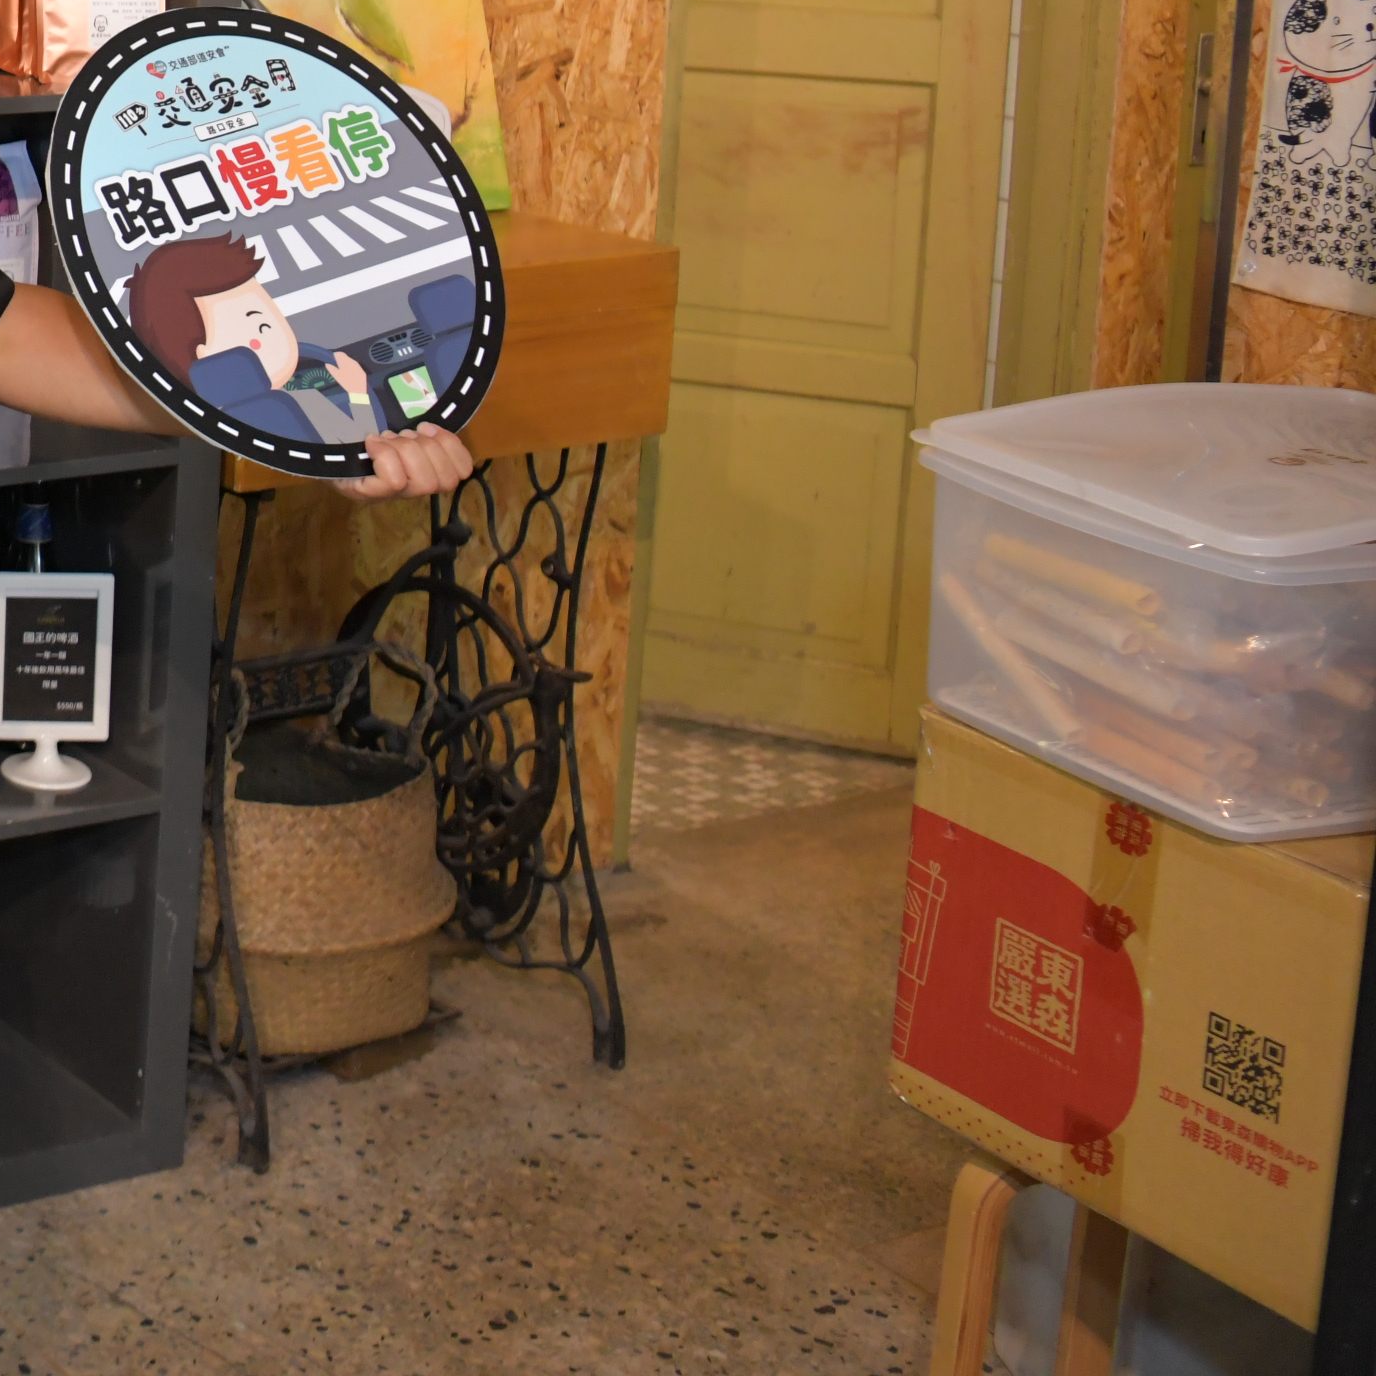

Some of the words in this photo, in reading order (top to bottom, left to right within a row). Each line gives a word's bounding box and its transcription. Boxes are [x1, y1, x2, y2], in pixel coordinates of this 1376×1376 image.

[167, 47, 226, 71] 交通部道安會
[206, 116, 246, 135] 路口安全
[100, 106, 392, 246] 路口慢看停
